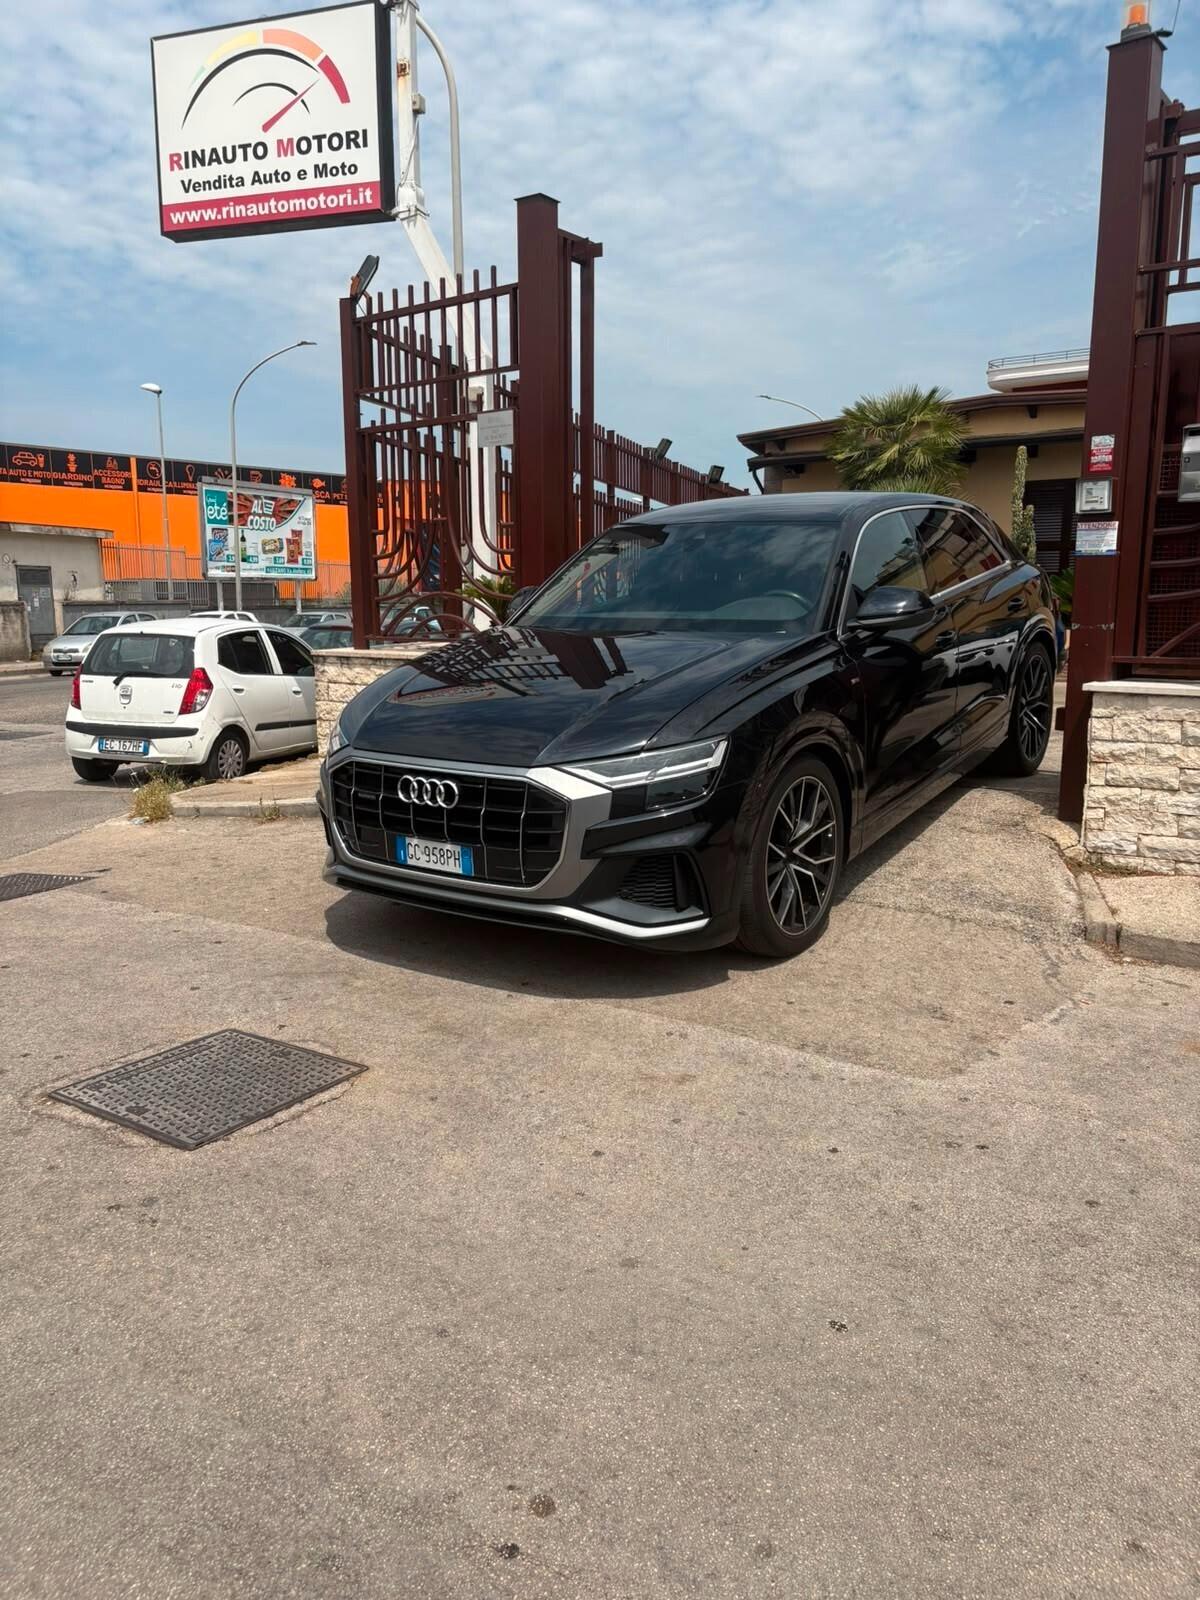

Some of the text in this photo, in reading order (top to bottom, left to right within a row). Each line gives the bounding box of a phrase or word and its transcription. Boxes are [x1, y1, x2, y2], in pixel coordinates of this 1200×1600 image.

[169, 129, 369, 171] RINAUTO MOTORI
[181, 161, 358, 193] Vendita Auto e Moto
[170, 188, 373, 225] www.rinautomotori.it
[9, 469, 27, 477] AUTO
[33, 471, 51, 479] MOTO
[52, 472, 93, 482] GIARDINO
[101, 476, 125, 485] BAGNO
[251, 500, 263, 514] AL
[248, 515, 277, 531] COSTO
[105, 740, 143, 751] EC 167HF
[407, 842, 421, 861] GC
[424, 845, 461, 868] 958PH
